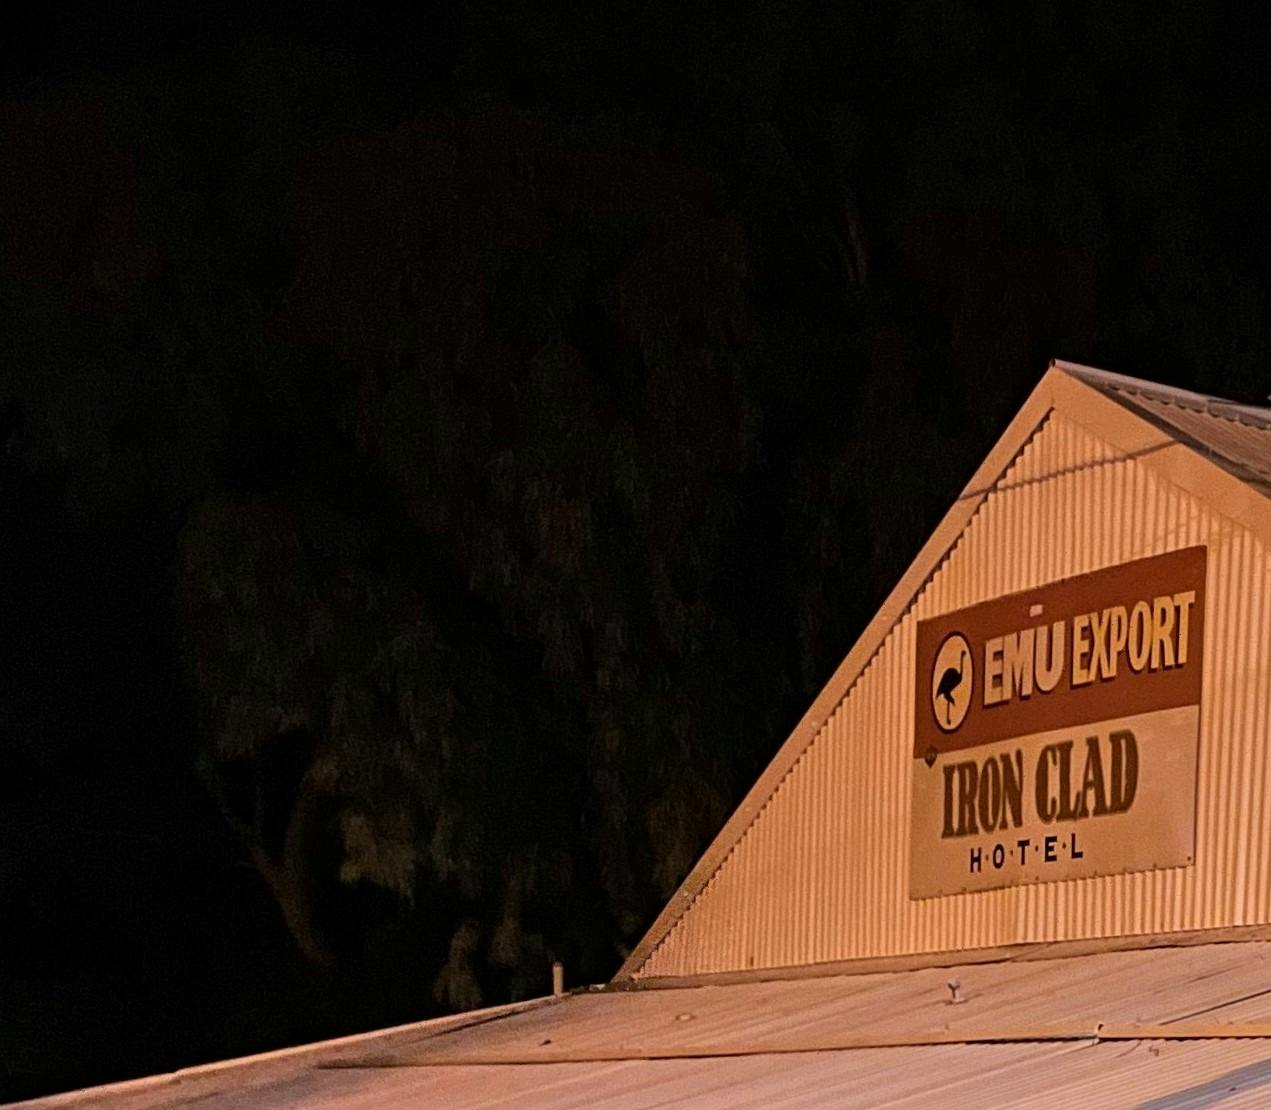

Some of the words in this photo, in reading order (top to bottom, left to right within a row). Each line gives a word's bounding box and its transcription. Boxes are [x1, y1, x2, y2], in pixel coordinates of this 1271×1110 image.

[983, 620, 1066, 707] EMU
[1071, 590, 1196, 686] EXPORT
[941, 749, 1024, 839] IRON
[1035, 729, 1140, 824] CLAD
